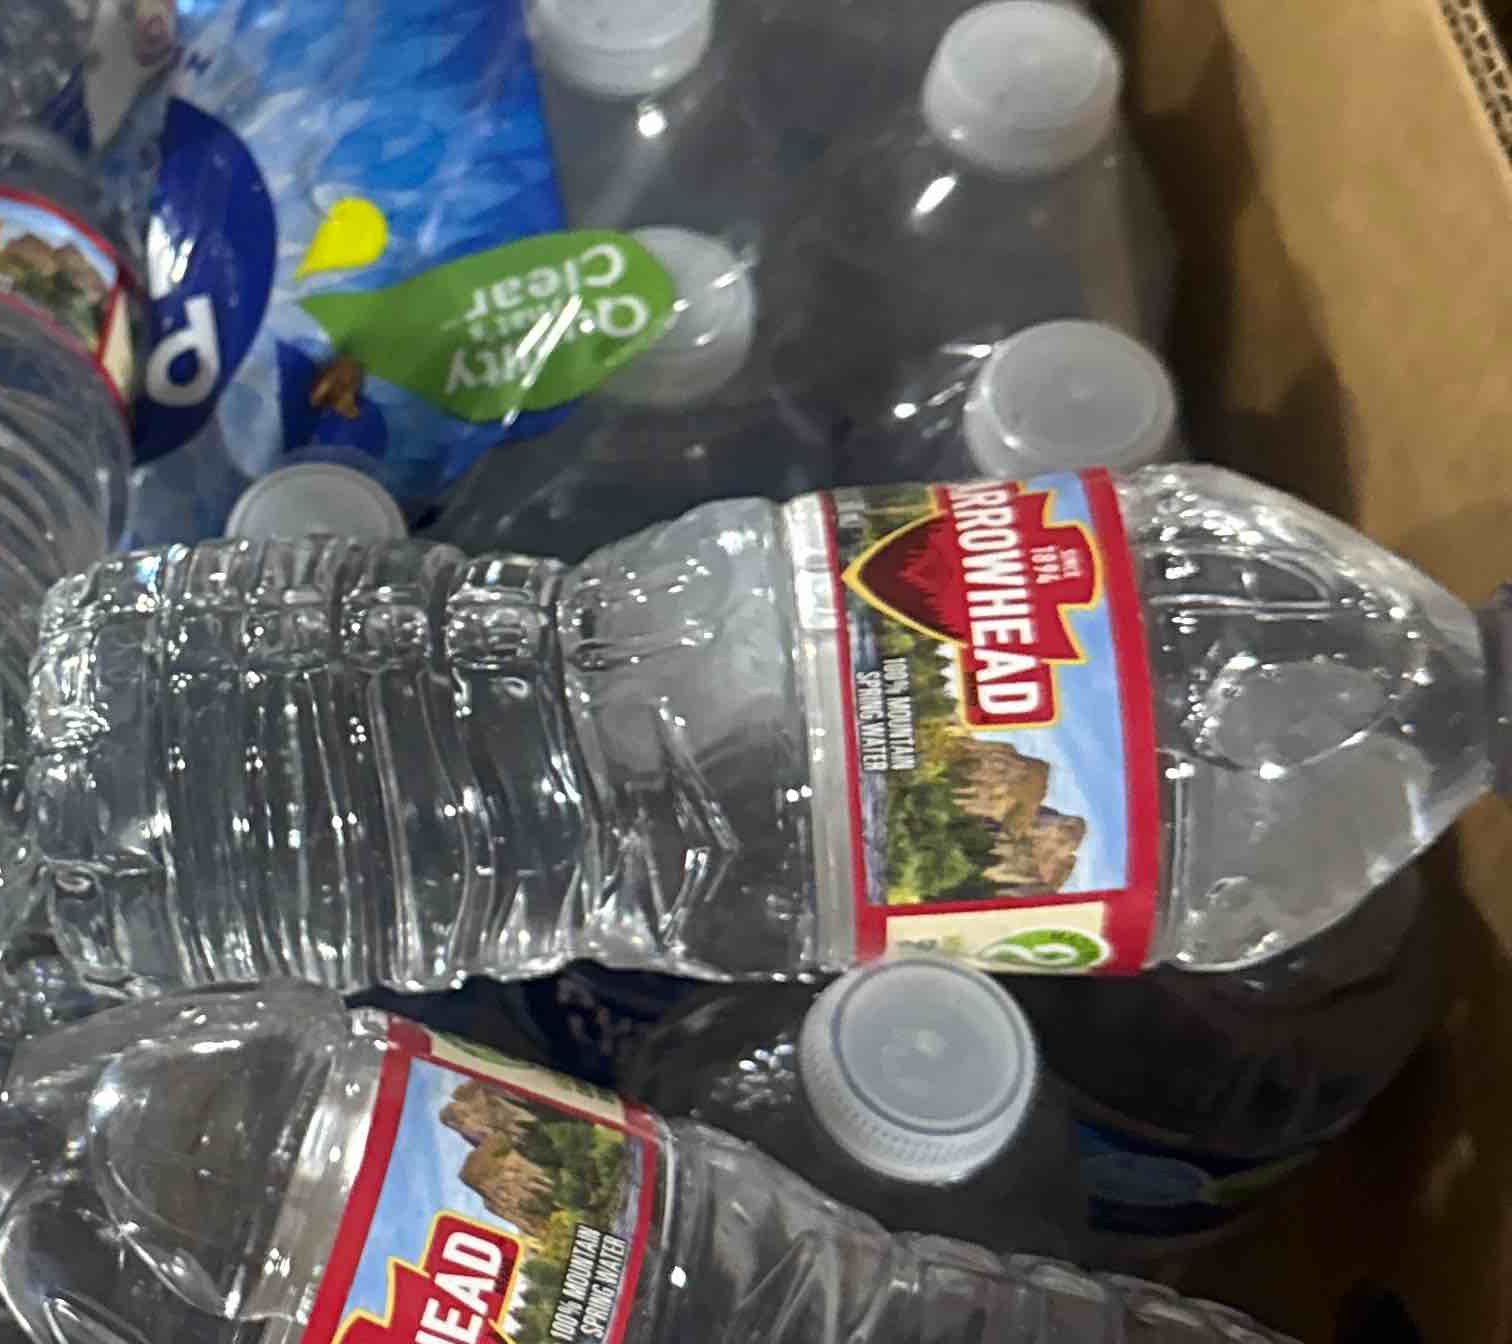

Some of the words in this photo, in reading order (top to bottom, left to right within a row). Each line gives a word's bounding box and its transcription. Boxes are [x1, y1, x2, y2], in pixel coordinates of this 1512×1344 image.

[465, 242, 627, 322] Clear
[1030, 544, 1053, 585] 1894
[1060, 547, 1082, 580] SINCE
[855, 670, 882, 726] SPRING
[861, 720, 889, 772] WATER
[888, 694, 918, 771] MOUNTAIN
[560, 1226, 602, 1301] MOUNTAIN
[579, 1281, 610, 1340] SPRING
[595, 1232, 627, 1285] WATER
[550, 1296, 579, 1342] 100%
